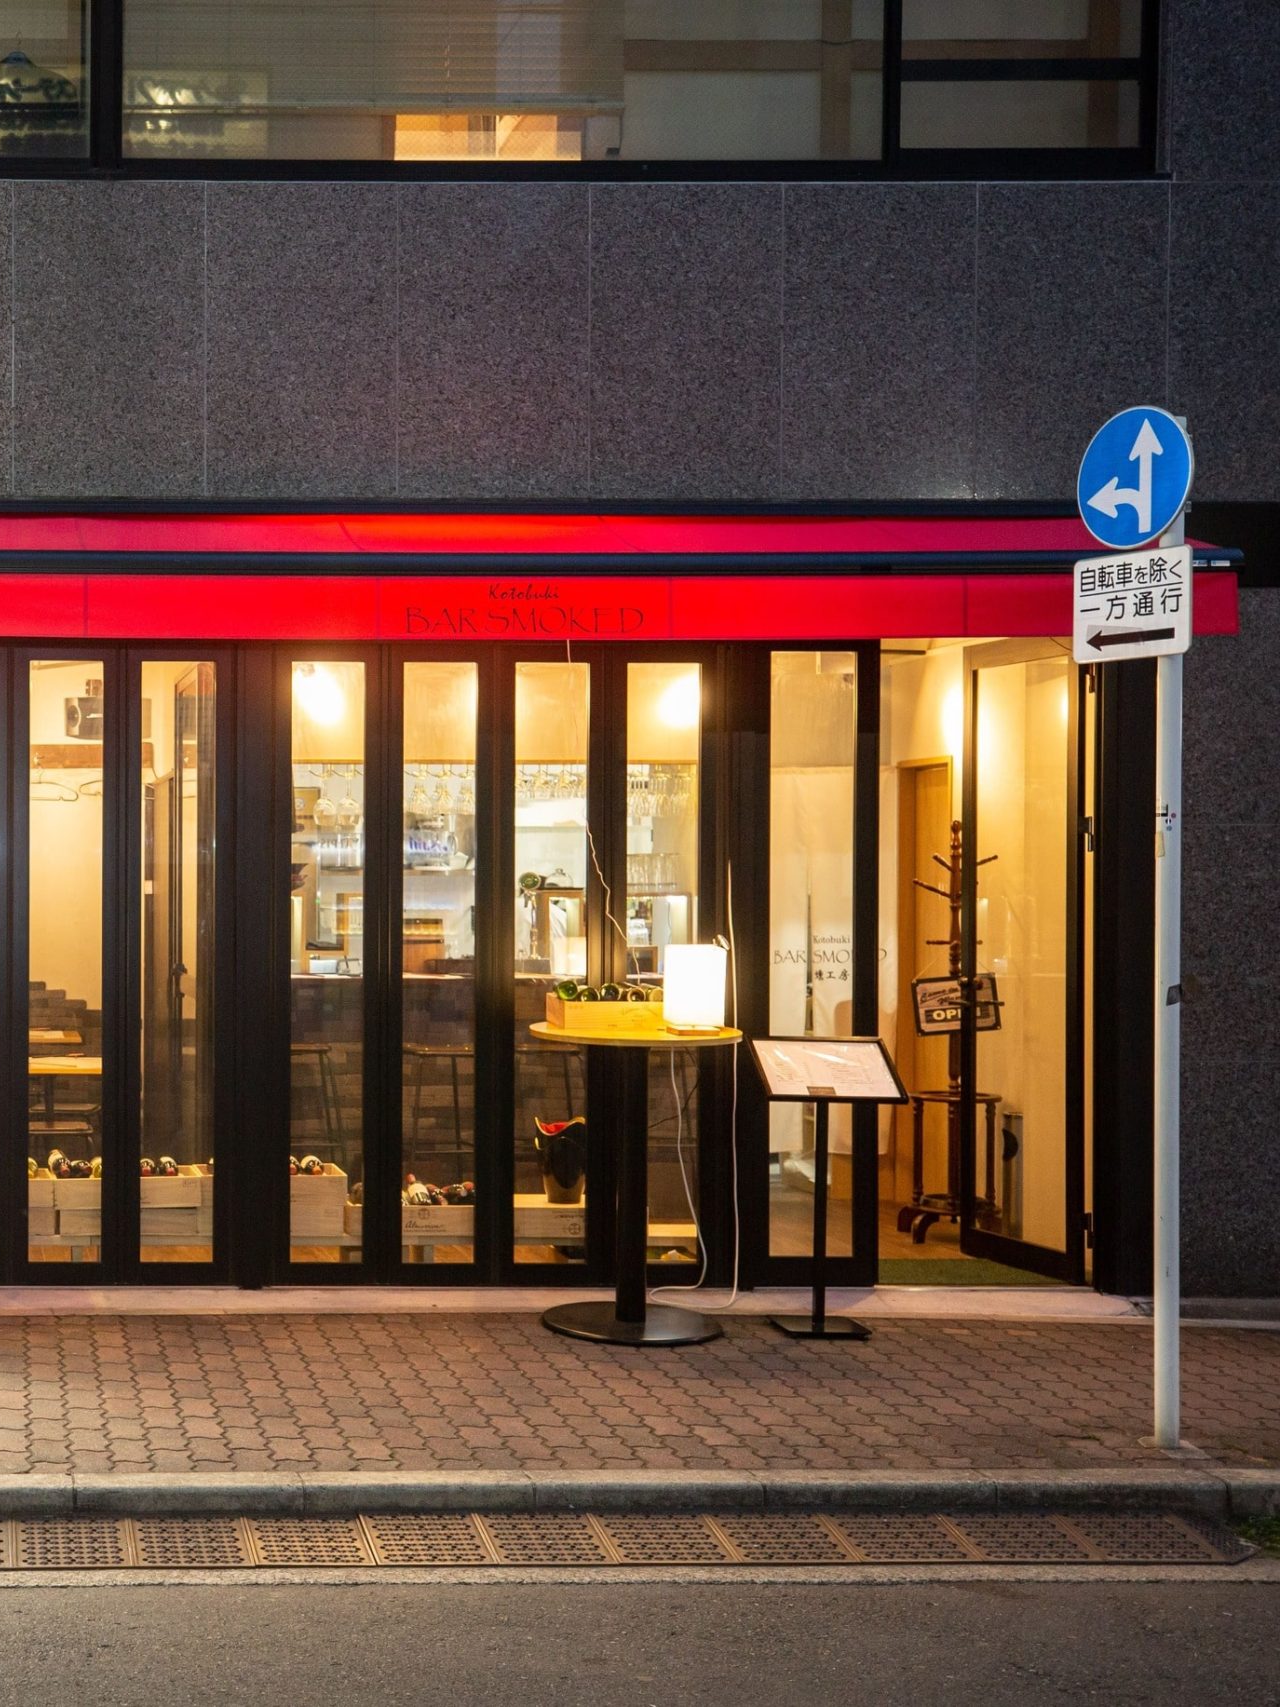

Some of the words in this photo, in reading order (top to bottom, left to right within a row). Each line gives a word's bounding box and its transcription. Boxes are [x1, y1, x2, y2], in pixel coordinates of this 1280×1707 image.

[1080, 556, 1182, 592] 自転車を除く
[487, 583, 559, 600] Kotobuki
[1080, 587, 1183, 621] 一方通行
[405, 606, 478, 634] BAR
[484, 606, 644, 634] SMOKED
[813, 935, 850, 944] Kotobuki
[773, 949, 807, 965] BAR
